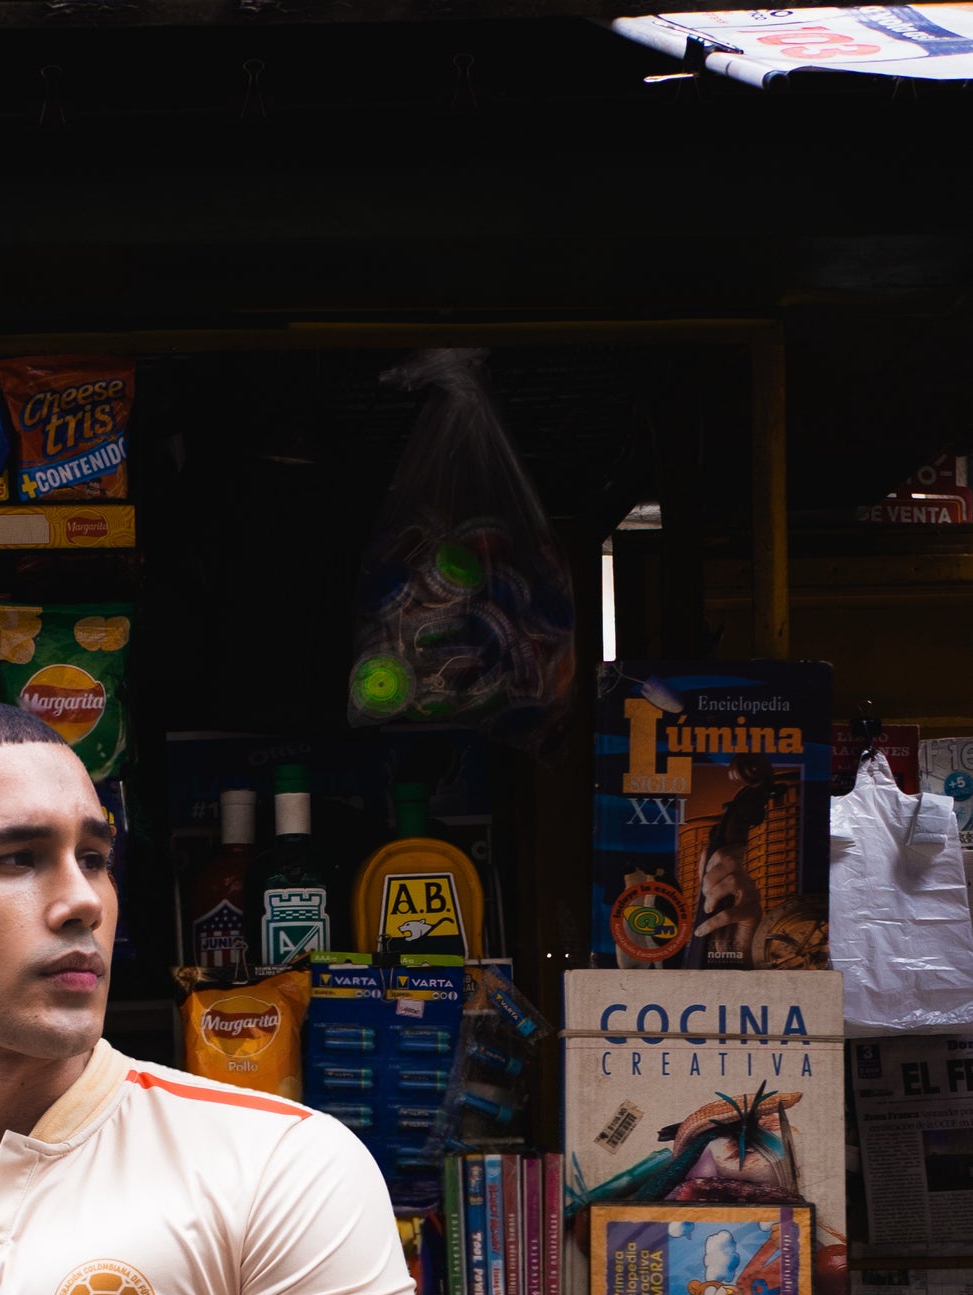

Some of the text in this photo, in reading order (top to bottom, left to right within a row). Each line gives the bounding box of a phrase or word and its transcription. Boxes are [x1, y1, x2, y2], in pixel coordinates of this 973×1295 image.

[23, 379, 124, 428] Cheese
[45, 402, 115, 457] tris
[66, 518, 108, 534] Margarita
[887, 506, 952, 525] VENTA
[698, 696, 790, 713] Enciclopedia
[623, 698, 804, 793] Lúmina
[628, 774, 687, 793] SIGLO
[950, 777, 966, 788] +5
[627, 798, 687, 825] XXI
[708, 950, 744, 960] norma
[334, 976, 377, 987] VARTA
[411, 979, 454, 988] VARTA
[500, 1000, 520, 1021] VARTA
[203, 1013, 277, 1036] Margarita
[601, 1003, 810, 1045] COCINA
[229, 1061, 258, 1072] Pollo
[602, 1052, 812, 1077] CREATIVA
[901, 1062, 940, 1096] EL
[472, 1231, 483, 1262] TOOL
[84, 1264, 131, 1278] COLOMBIANA
[131, 1275, 142, 1286] DE
